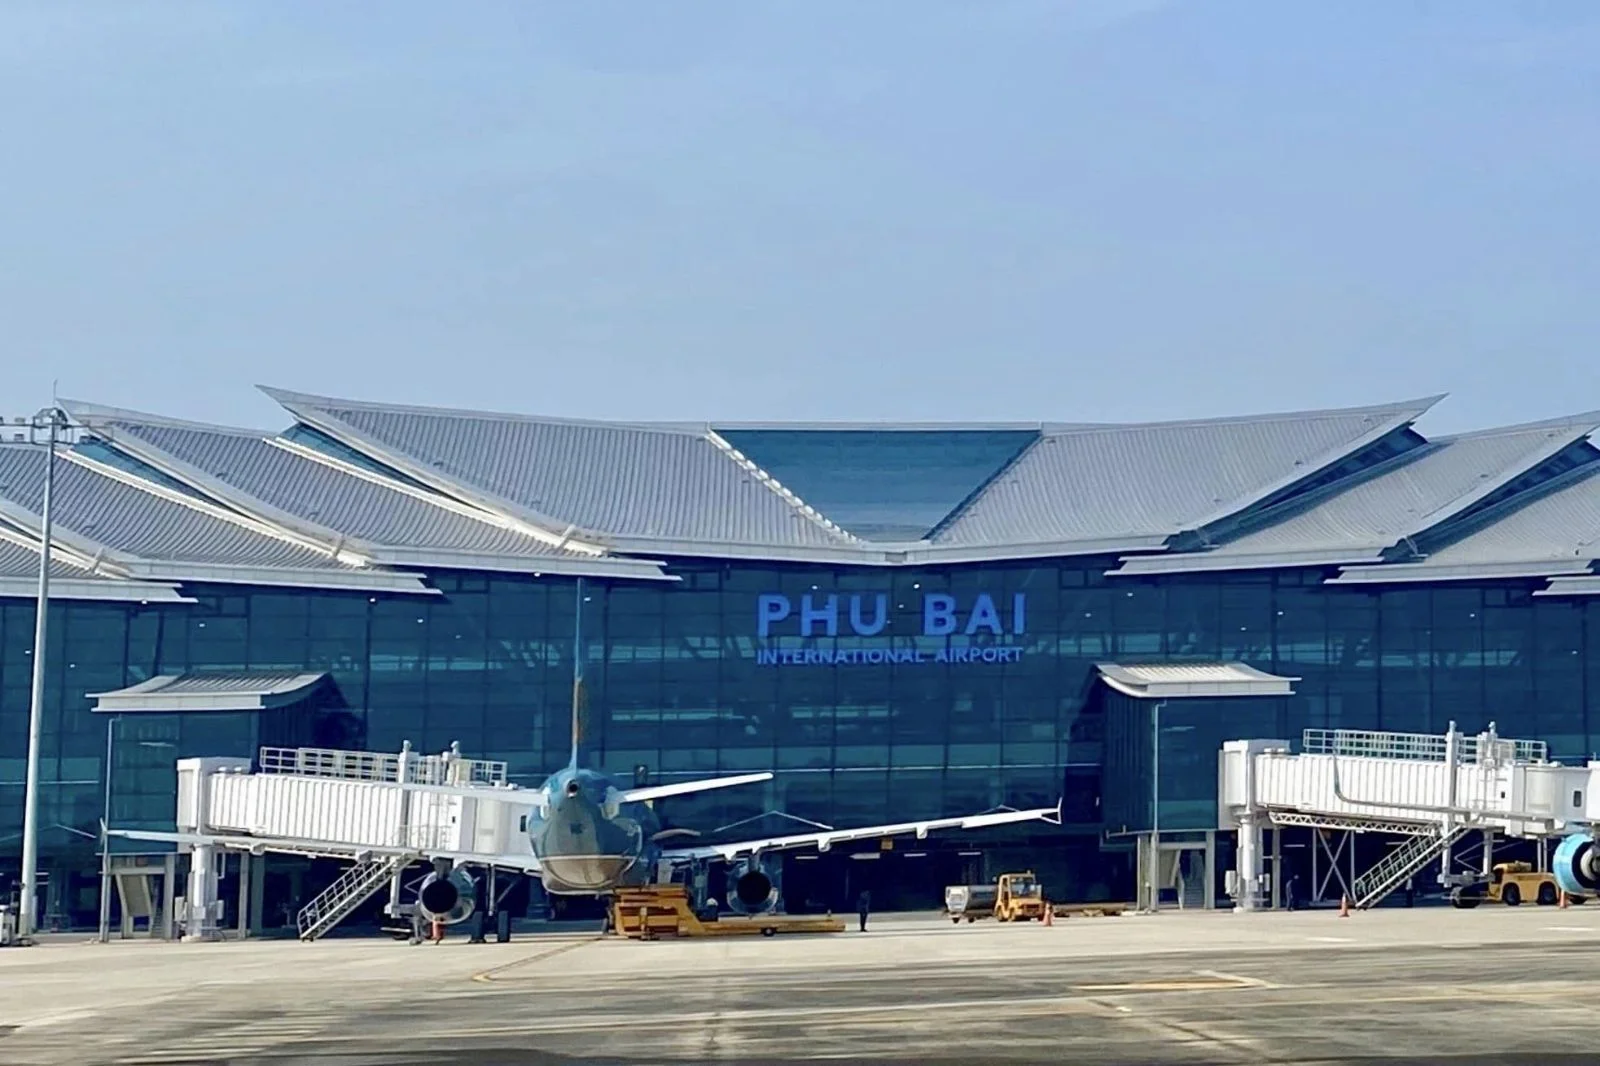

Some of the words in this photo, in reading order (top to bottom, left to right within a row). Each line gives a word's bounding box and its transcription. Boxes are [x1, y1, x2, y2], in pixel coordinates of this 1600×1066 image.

[757, 593, 888, 637] PHU
[924, 592, 1026, 635] BAI
[757, 648, 925, 665] INTERNATIONAL
[934, 646, 1023, 663] AIRPORT
